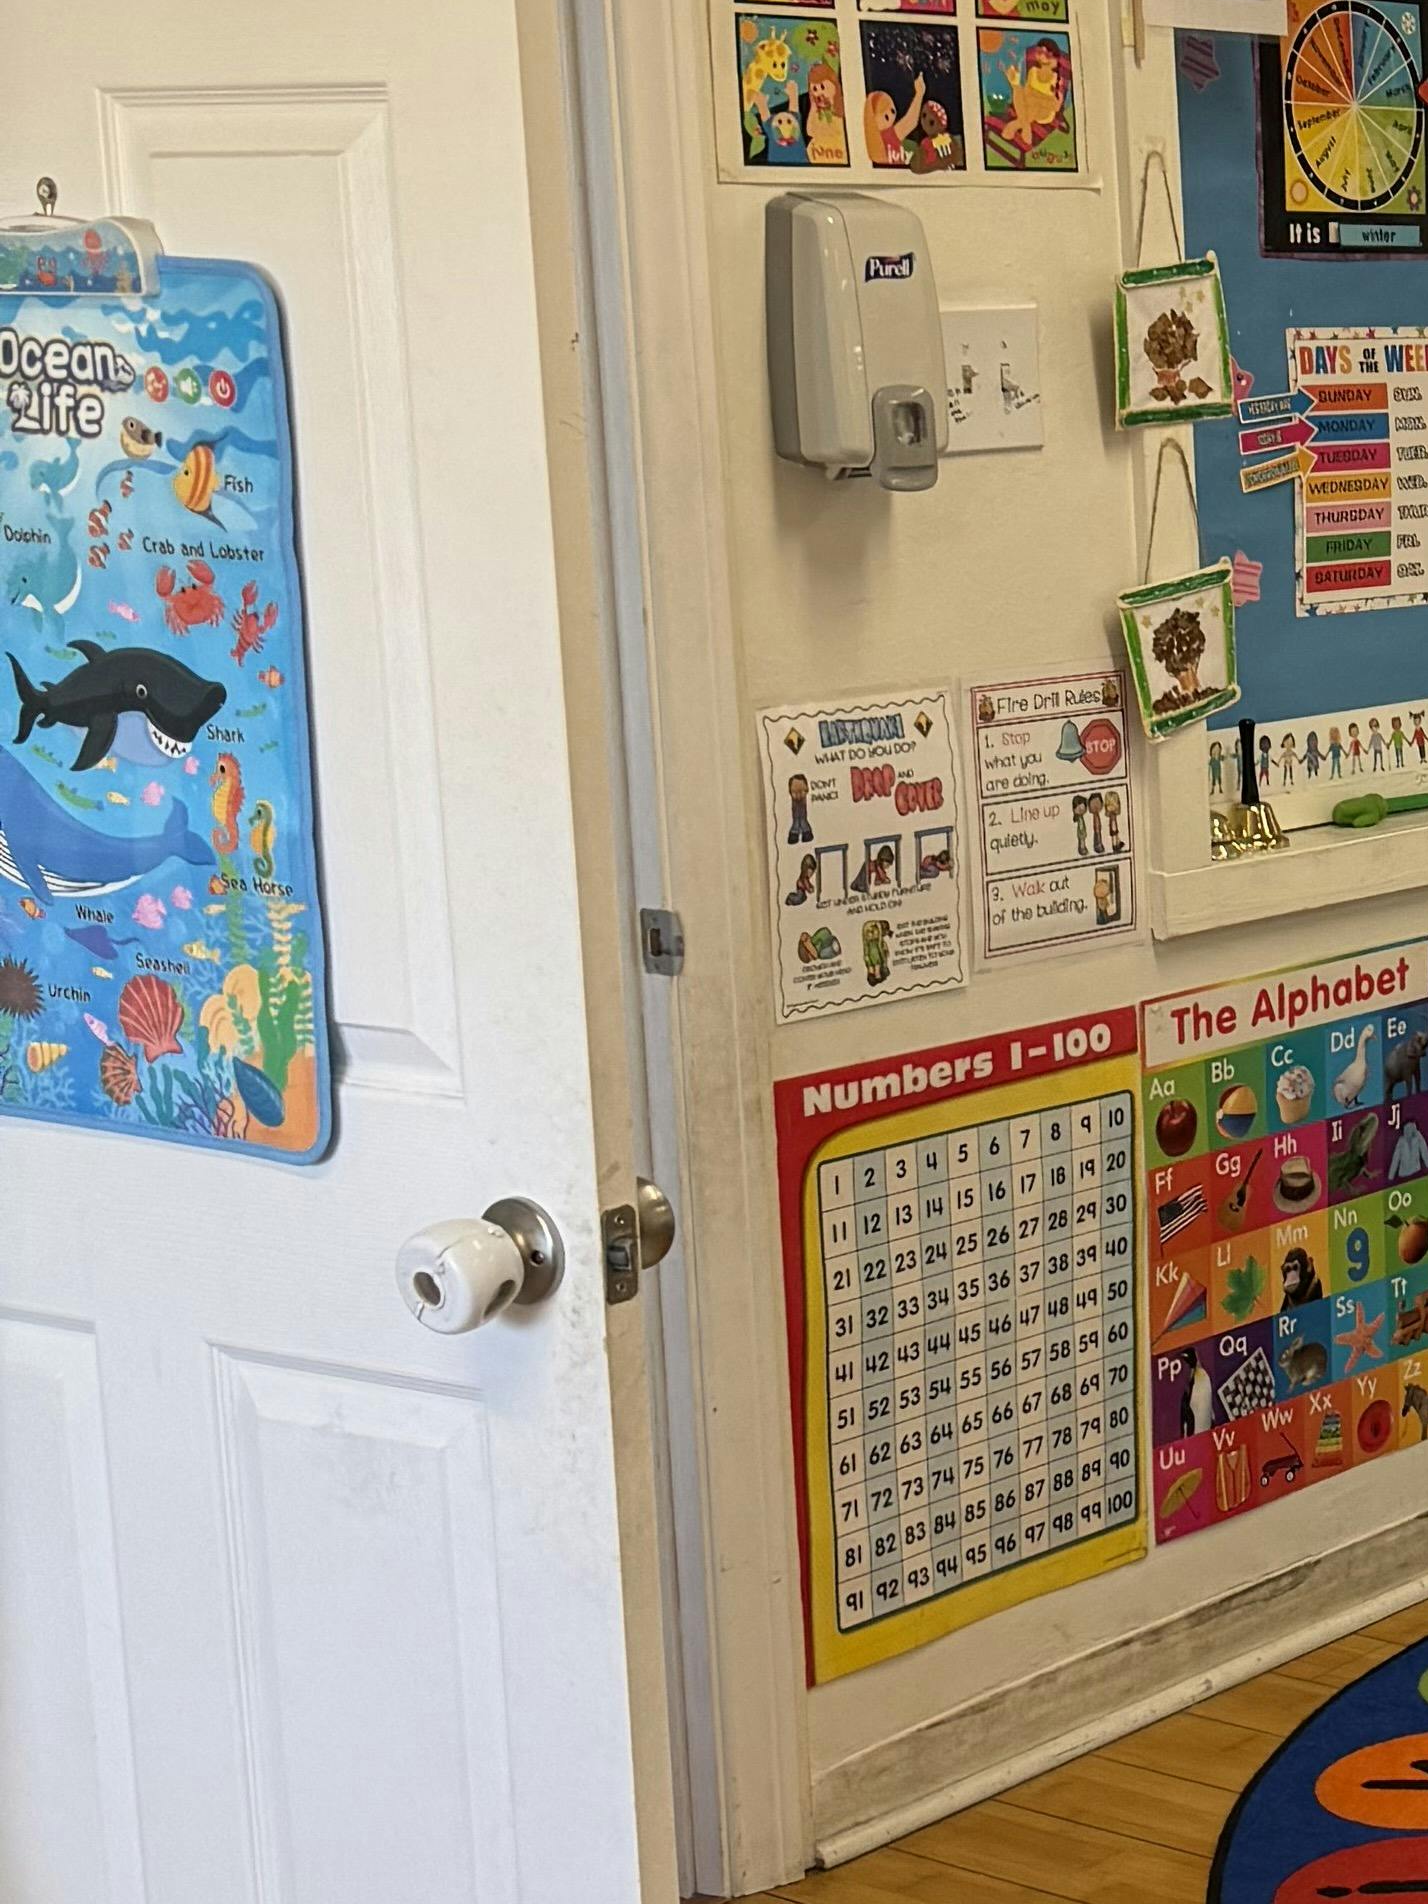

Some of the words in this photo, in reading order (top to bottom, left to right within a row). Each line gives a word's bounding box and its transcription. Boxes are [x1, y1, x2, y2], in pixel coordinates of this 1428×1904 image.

[1026, 0, 1060, 15] may
[1290, 223, 1303, 243] It
[1307, 223, 1321, 244] is
[1362, 227, 1396, 245] winter
[869, 258, 911, 277] Purell
[0, 327, 117, 383] Ocean
[1299, 346, 1350, 375] DAYS
[1363, 348, 1375, 360] OF
[1359, 361, 1379, 374] THE
[1318, 389, 1372, 403] SUNDAY
[8, 382, 104, 437] Life
[1318, 419, 1375, 432] MONDAY
[1318, 449, 1377, 464] TUESDAY
[224, 475, 254, 493] Fish
[1309, 478, 1388, 494] WEDNESDAY
[1314, 507, 1384, 524] THURSDAY
[4, 526, 51, 543] Dolphin
[143, 537, 175, 555] Crab
[182, 539, 204, 557] and
[210, 542, 264, 561] Lobster
[1326, 539, 1372, 553] FRIDAY
[1315, 566, 1383, 583] SATURDAY
[997, 698, 1028, 714] Fire
[1034, 692, 1060, 710] Drill
[1065, 690, 1101, 706] Rules
[207, 723, 245, 743] Shark
[1001, 732, 1030, 747] Stop
[814, 750, 844, 765] WHAT
[848, 748, 865, 762] DO
[868, 745, 892, 760] YOU
[1086, 739, 1116, 753] STOP
[985, 756, 1016, 770] what
[1019, 752, 1042, 768] you
[850, 763, 895, 803] DROP
[986, 779, 1009, 792] are
[1013, 772, 1050, 789] doing.
[894, 777, 944, 816] COVER
[1010, 807, 1040, 824] Line
[1044, 804, 1060, 818] up
[990, 831, 1038, 853] quietly.
[221, 875, 248, 892] Sea
[253, 877, 293, 896] Horse
[1050, 877, 1070, 891] out
[75, 905, 114, 923] Whale
[1012, 905, 1033, 921] the
[1036, 900, 1088, 918] building.
[136, 955, 191, 976] Seashell
[48, 985, 91, 1002] Urchin
[1171, 1002, 1237, 1045] The
[1251, 957, 1409, 1028] Alphabet
[803, 1051, 993, 1117] Numbers
